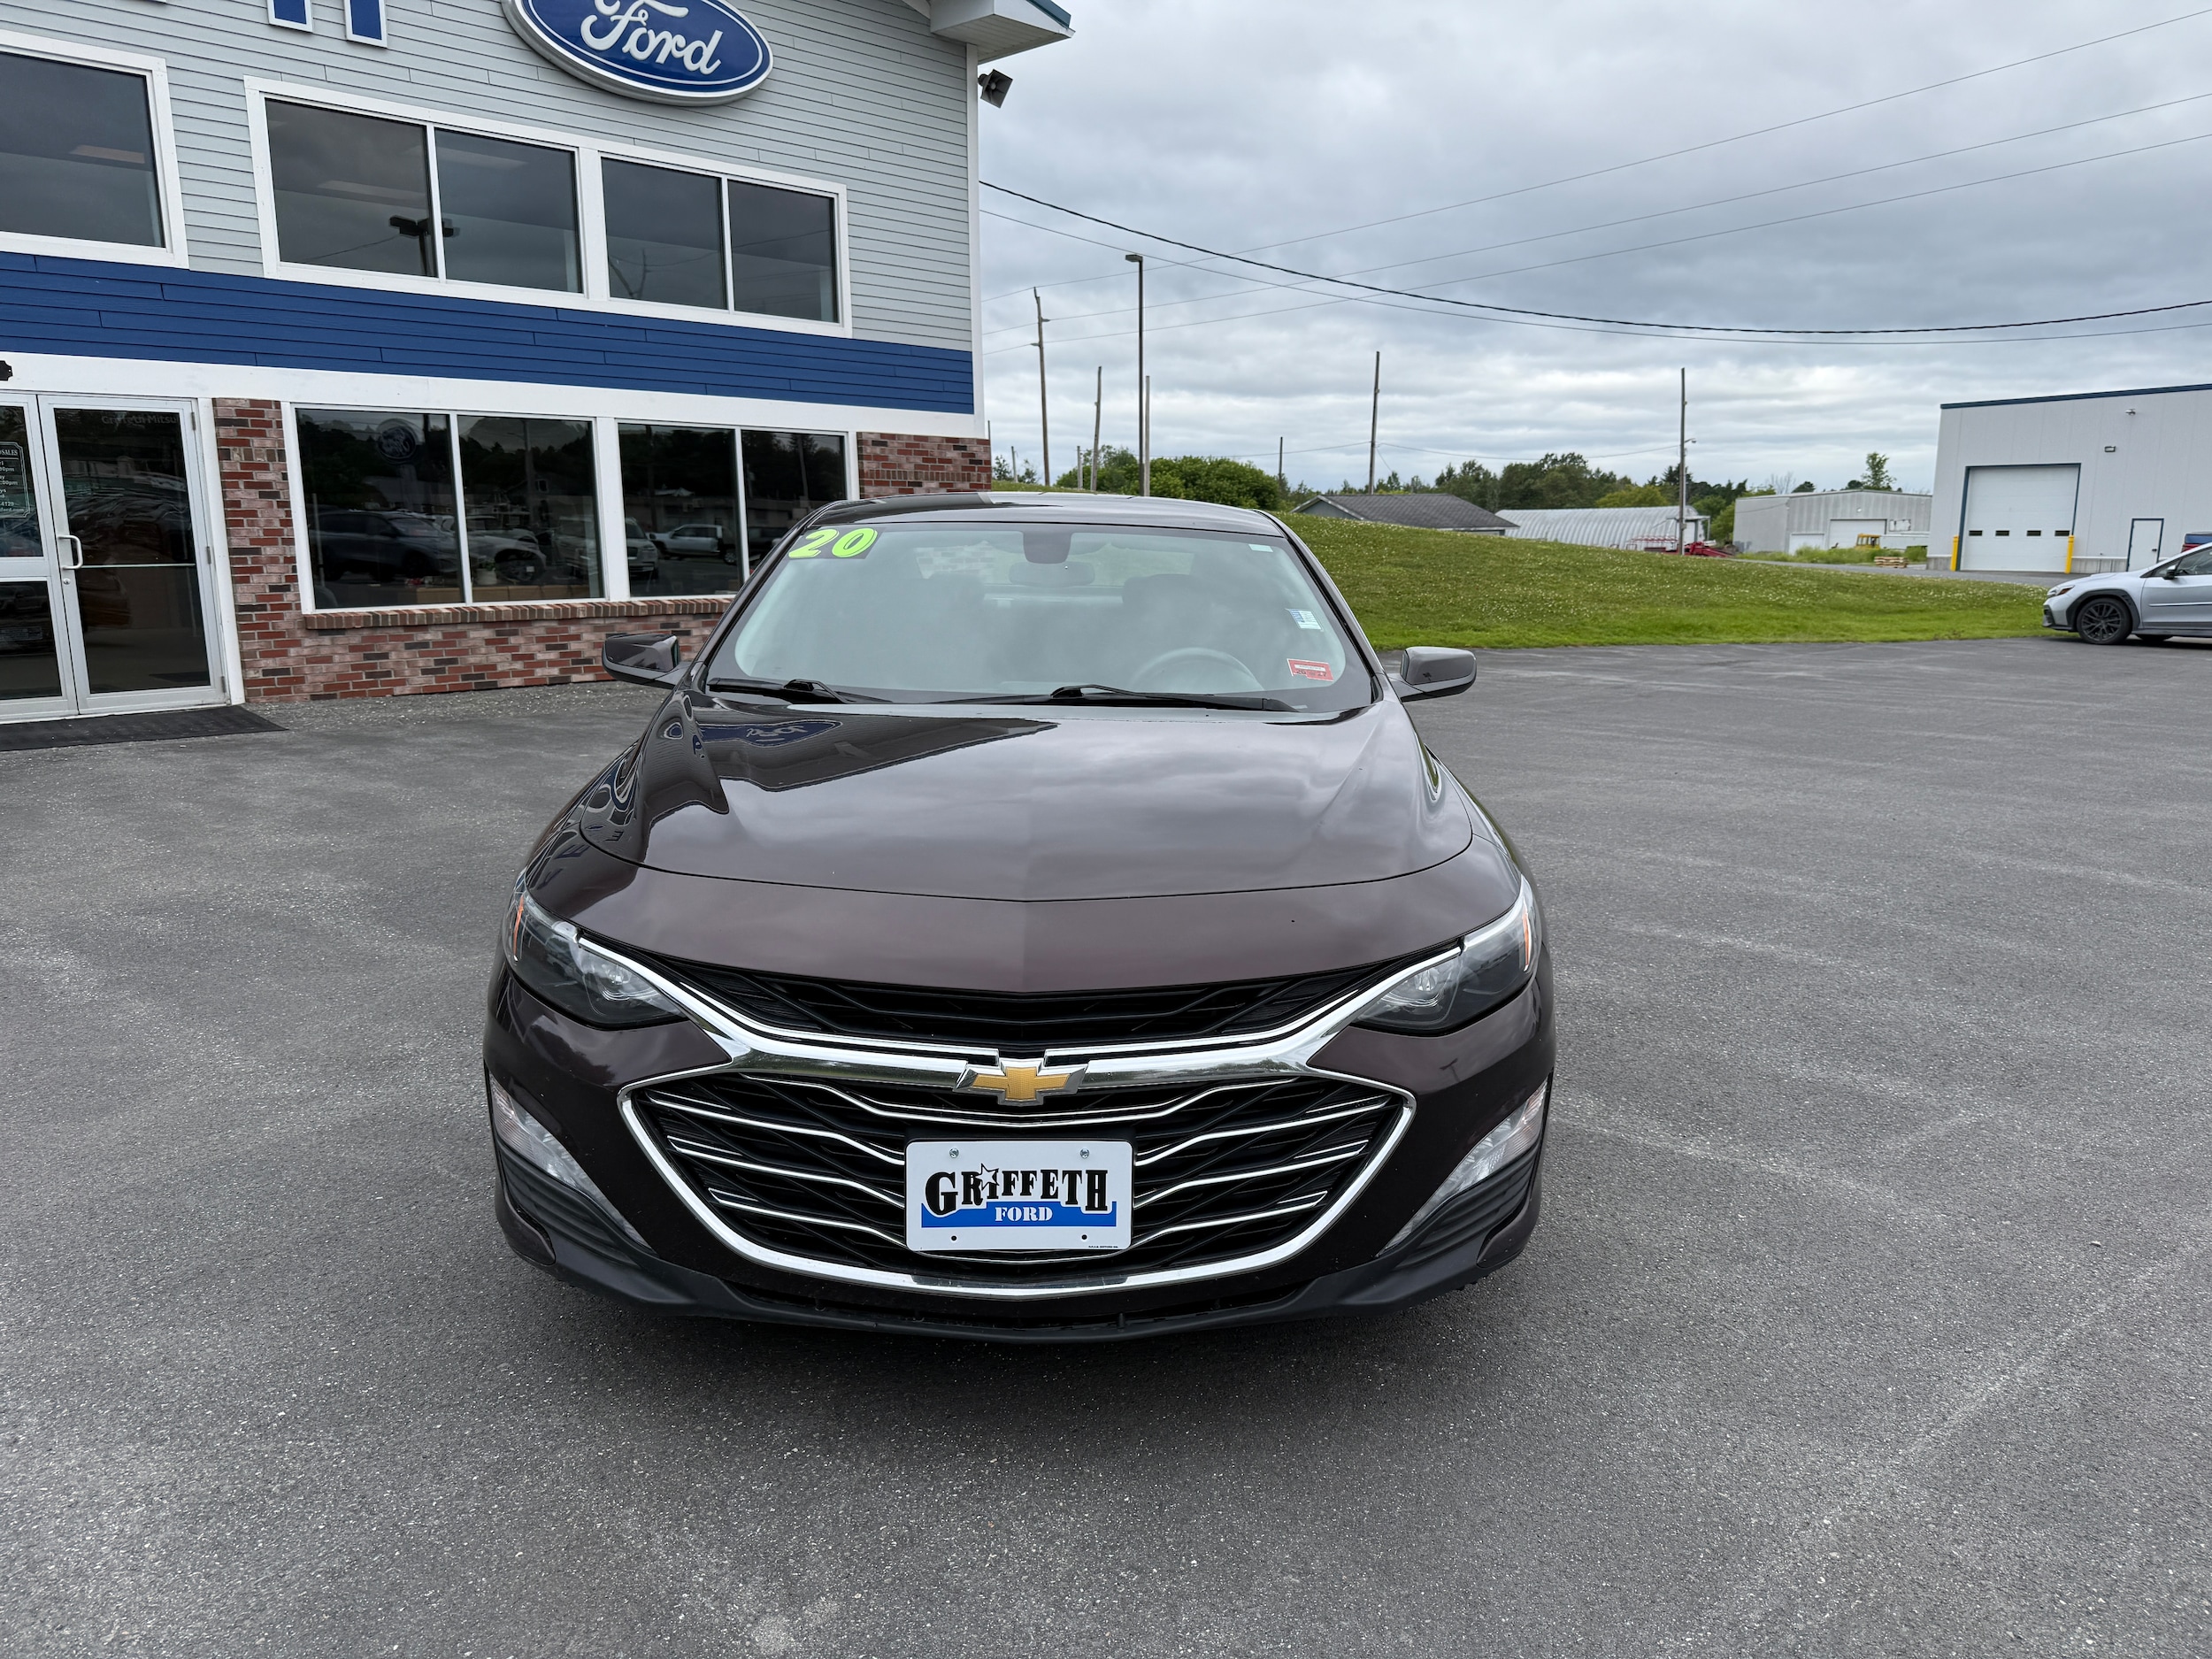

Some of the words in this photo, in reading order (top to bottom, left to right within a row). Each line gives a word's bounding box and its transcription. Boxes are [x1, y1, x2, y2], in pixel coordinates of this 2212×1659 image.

[580, 0, 724, 74] Ford
[788, 527, 879, 558] 20
[925, 1168, 1109, 1216] GRIFFETH
[995, 1206, 1054, 1223] FORD
